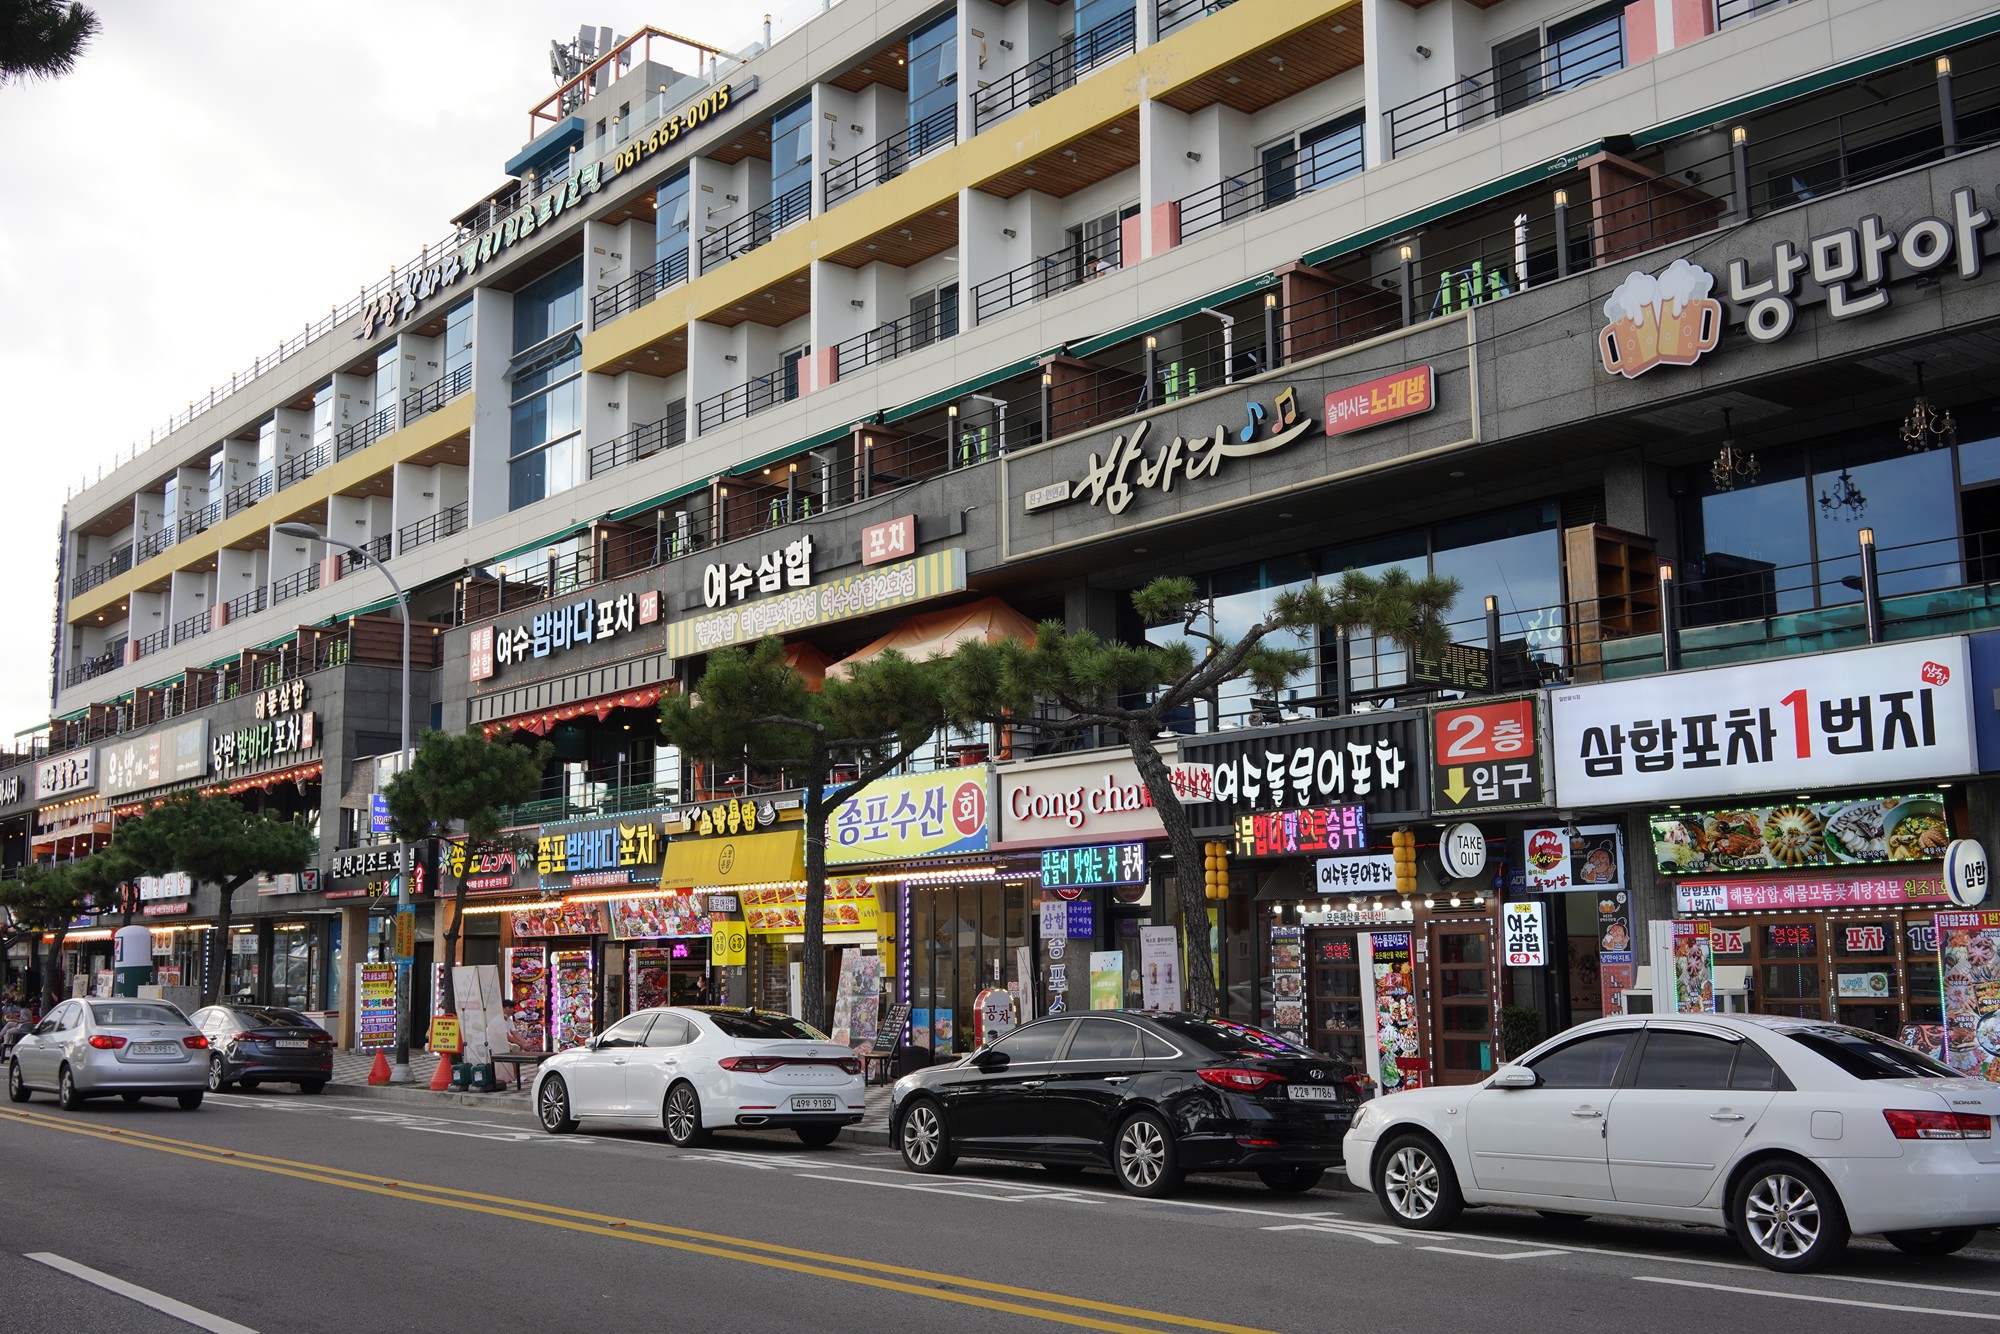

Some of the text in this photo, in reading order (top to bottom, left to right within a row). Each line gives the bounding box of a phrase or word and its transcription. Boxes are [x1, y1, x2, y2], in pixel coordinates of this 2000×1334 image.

[615, 84, 729, 174] 061-665-0015
[1328, 375, 1426, 424] 술마시는 노래방
[1072, 420, 1312, 514] 밤바다
[870, 522, 905, 558] 포차
[703, 534, 813, 608] 여수삼합
[642, 597, 656, 618] 2F
[741, 591, 817, 635] 리얼포차감성
[820, 565, 916, 618] 여수삼합2호점
[471, 629, 492, 651] 해물
[255, 679, 304, 720] 해물삼합
[1447, 715, 1524, 757] 2층
[1580, 688, 1937, 778] 삼합포차1번지
[1214, 739, 1405, 808] 여수돌문어포차
[1472, 763, 1533, 801] 입구
[1007, 785, 1084, 828] Gong
[1087, 774, 1144, 814] cha
[699, 799, 756, 836] 노랑통닭
[838, 786, 948, 846] 종포수산
[958, 789, 979, 829] 회
[1458, 836, 1482, 850] TAKE
[1043, 845, 1142, 886] 공들여 맛있는 차 공차
[1460, 852, 1480, 866] OUT
[417, 867, 423, 883] 2
[1321, 862, 1393, 887] 여수돌문어포차
[1965, 860, 1988, 891] 삼합
[368, 882, 383, 897] 입구
[384, 881, 390, 895] 3
[391, 880, 398, 895] 4
[1042, 911, 1066, 930] 삼합
[1507, 913, 1539, 933] 여수
[1939, 913, 1980, 928] 삼합포차
[1508, 933, 1541, 953] 삼합
[1773, 926, 1812, 945] 영업중
[1846, 927, 1885, 951] 포차
[1600, 953, 1632, 963] 낭만아지트
[986, 1004, 1011, 1025] 공차
[813, 1099, 832, 1108] 9189
[1312, 1088, 1332, 1099] 7786
